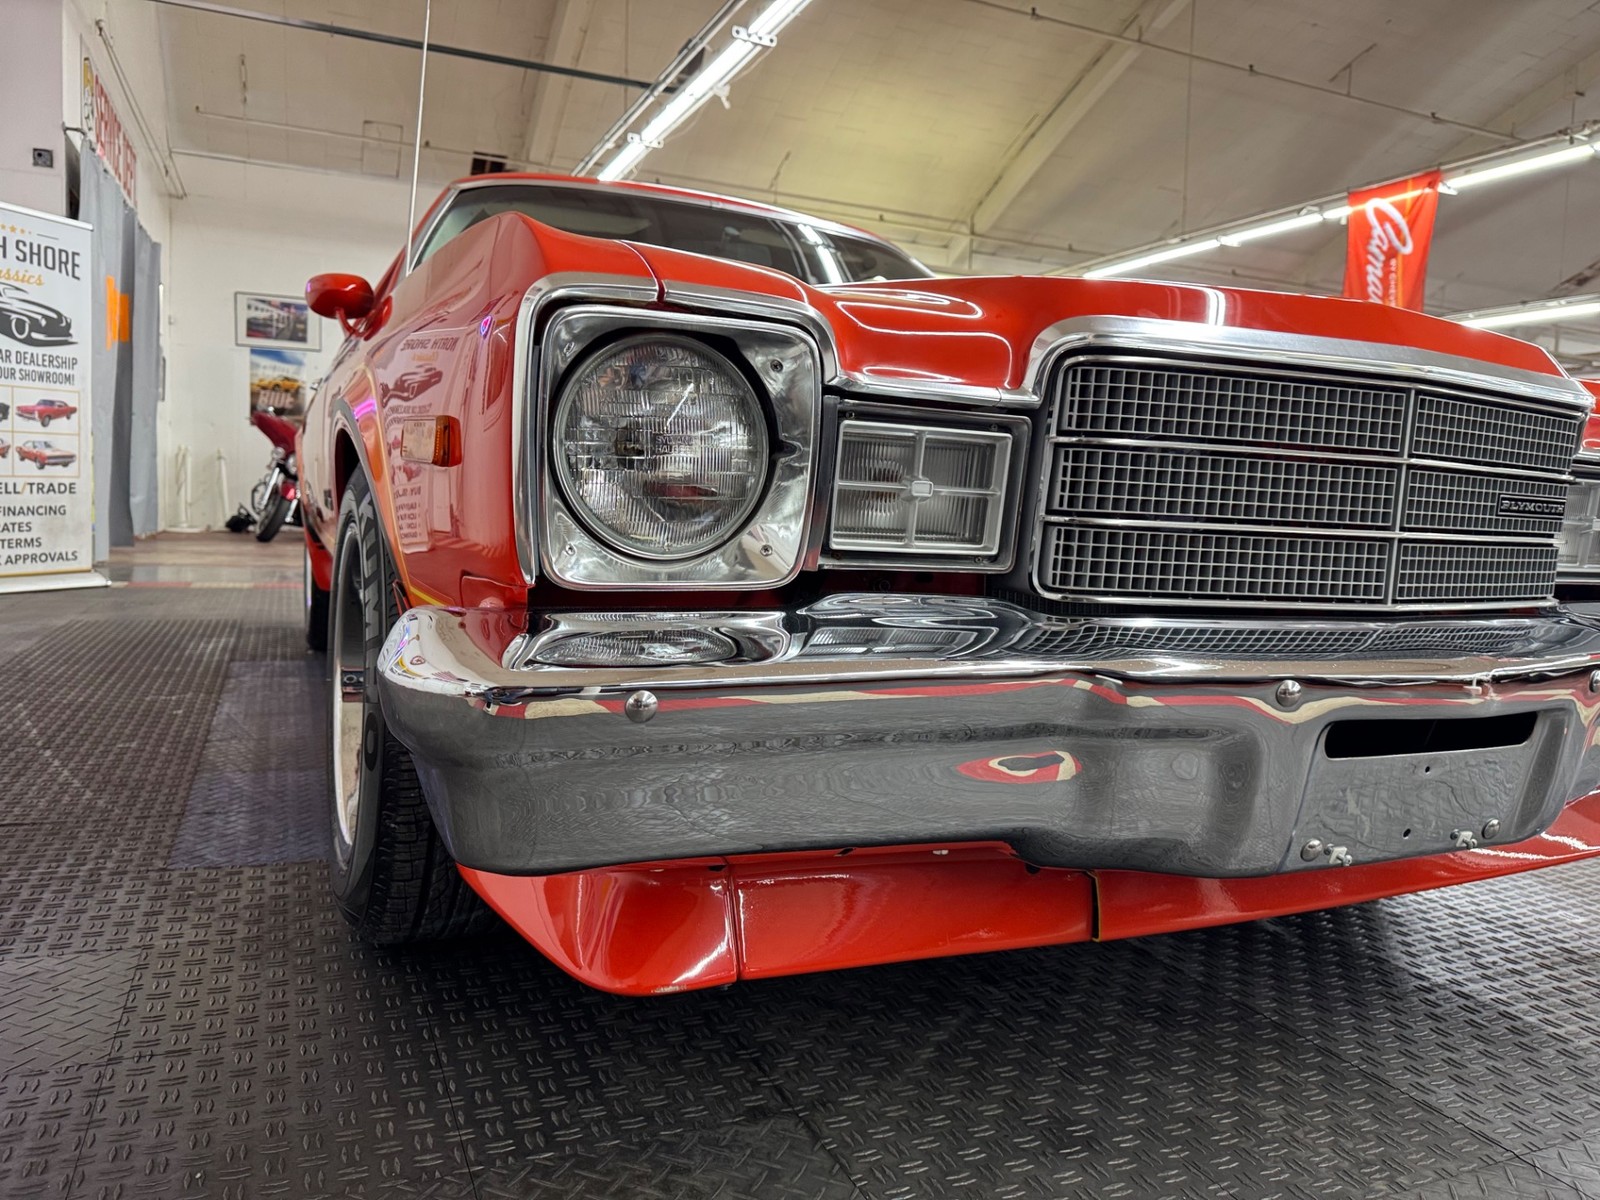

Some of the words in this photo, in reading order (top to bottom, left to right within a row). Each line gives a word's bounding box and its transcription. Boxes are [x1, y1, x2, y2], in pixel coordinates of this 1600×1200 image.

[1365, 197, 1413, 304] Cama
[15, 239, 81, 281] SHORE
[15, 350, 78, 371] DEALERSHIP
[19, 368, 75, 386] SHOWROOM!
[0, 504, 67, 517] INANCING
[1500, 500, 1565, 513] PLYMOUTH
[0, 521, 32, 533] ATES
[0, 536, 42, 549] TERMS
[4, 550, 78, 565] APPROVALS
